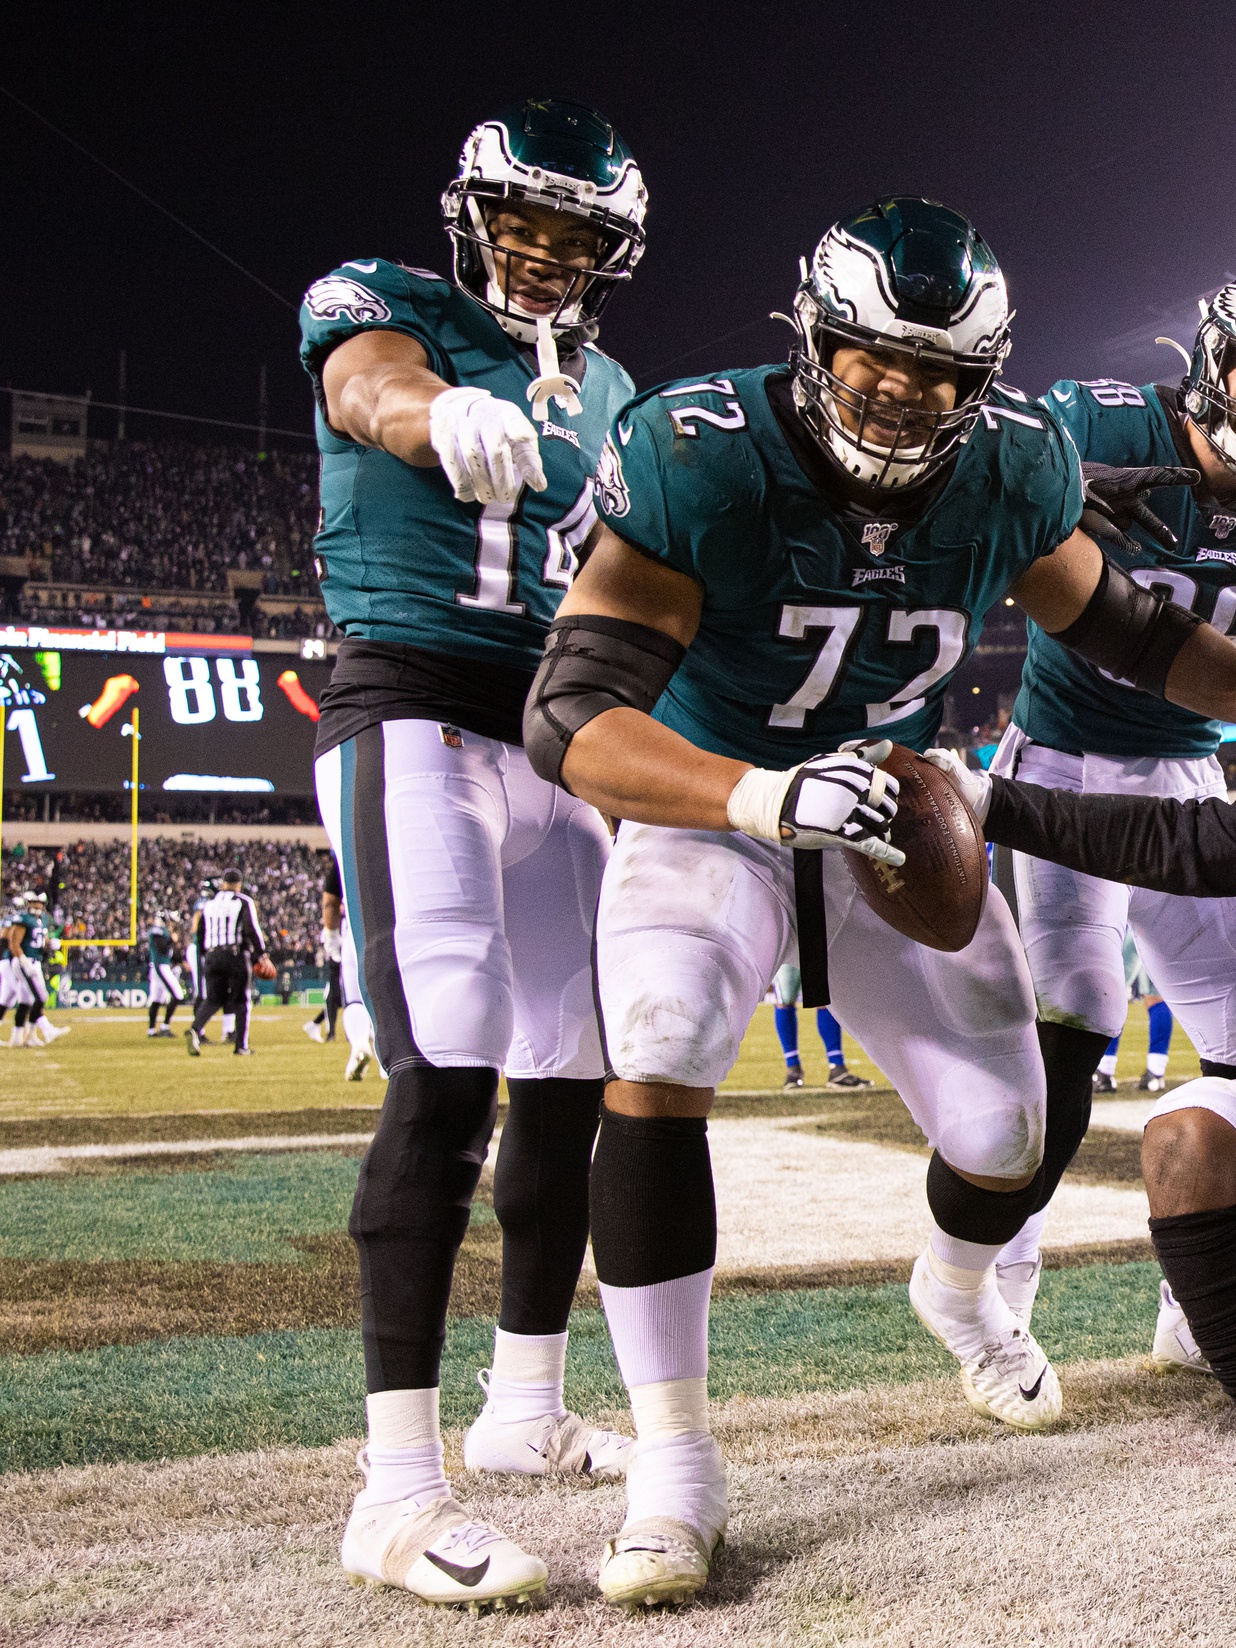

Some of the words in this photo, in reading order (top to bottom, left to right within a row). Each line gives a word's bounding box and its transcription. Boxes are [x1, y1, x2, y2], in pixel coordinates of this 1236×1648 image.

[541, 419, 581, 449] EAGLES
[852, 565, 906, 588] EAGLES
[768, 604, 967, 729] 72
[903, 761, 927, 790] LEAGUE
[925, 790, 950, 836] FOOTBALL
